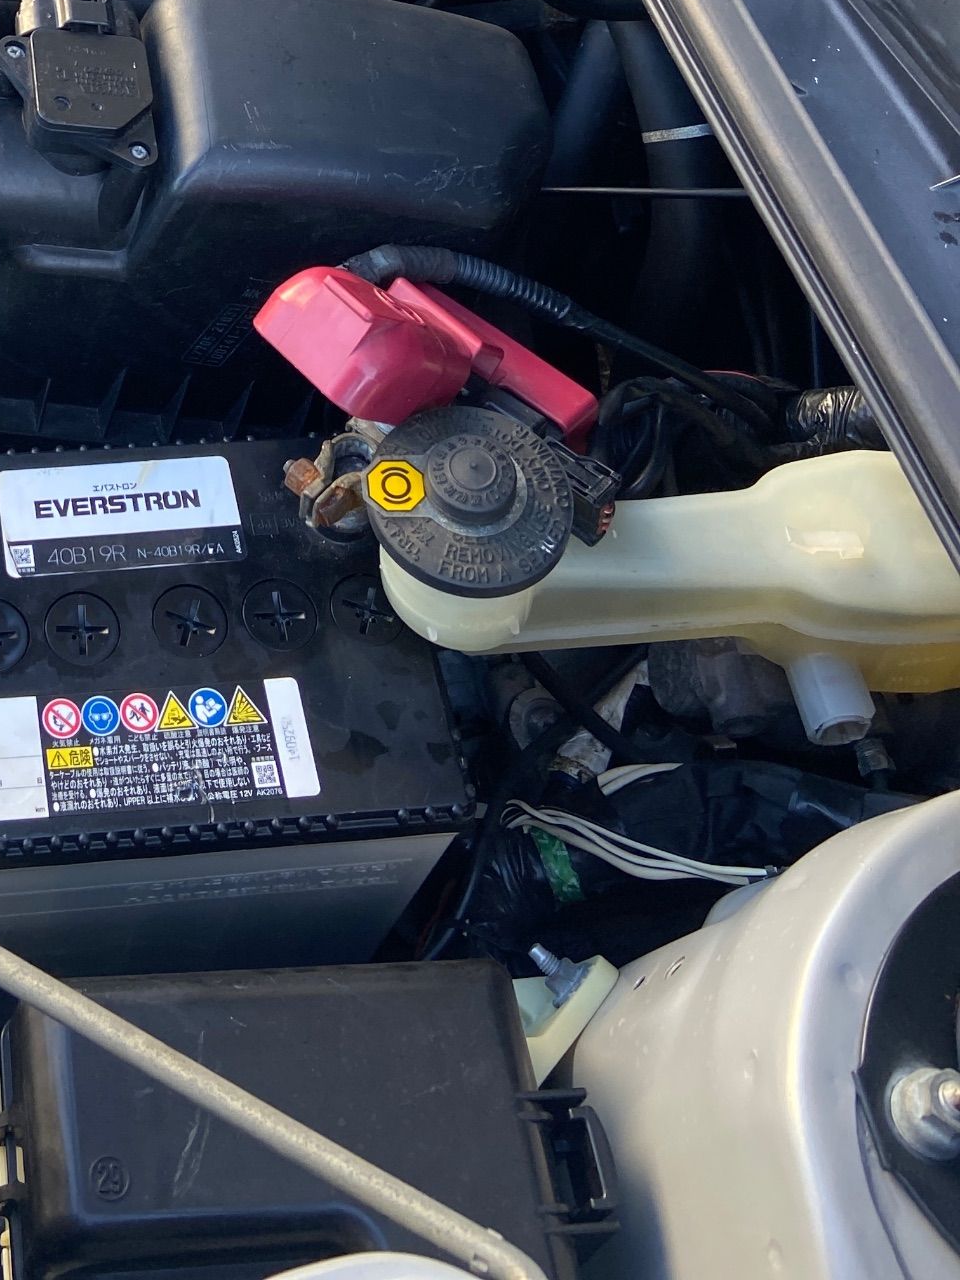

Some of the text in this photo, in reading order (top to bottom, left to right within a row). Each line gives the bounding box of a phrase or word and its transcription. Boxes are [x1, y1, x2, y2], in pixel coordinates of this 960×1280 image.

[33, 489, 202, 519] EVERSTRON
[47, 544, 127, 566] 40B19R
[437, 559, 490, 583] FROM
[69, 749, 92, 767] 危険
[240, 790, 253, 798] 12V
[256, 788, 283, 796] AK2076
